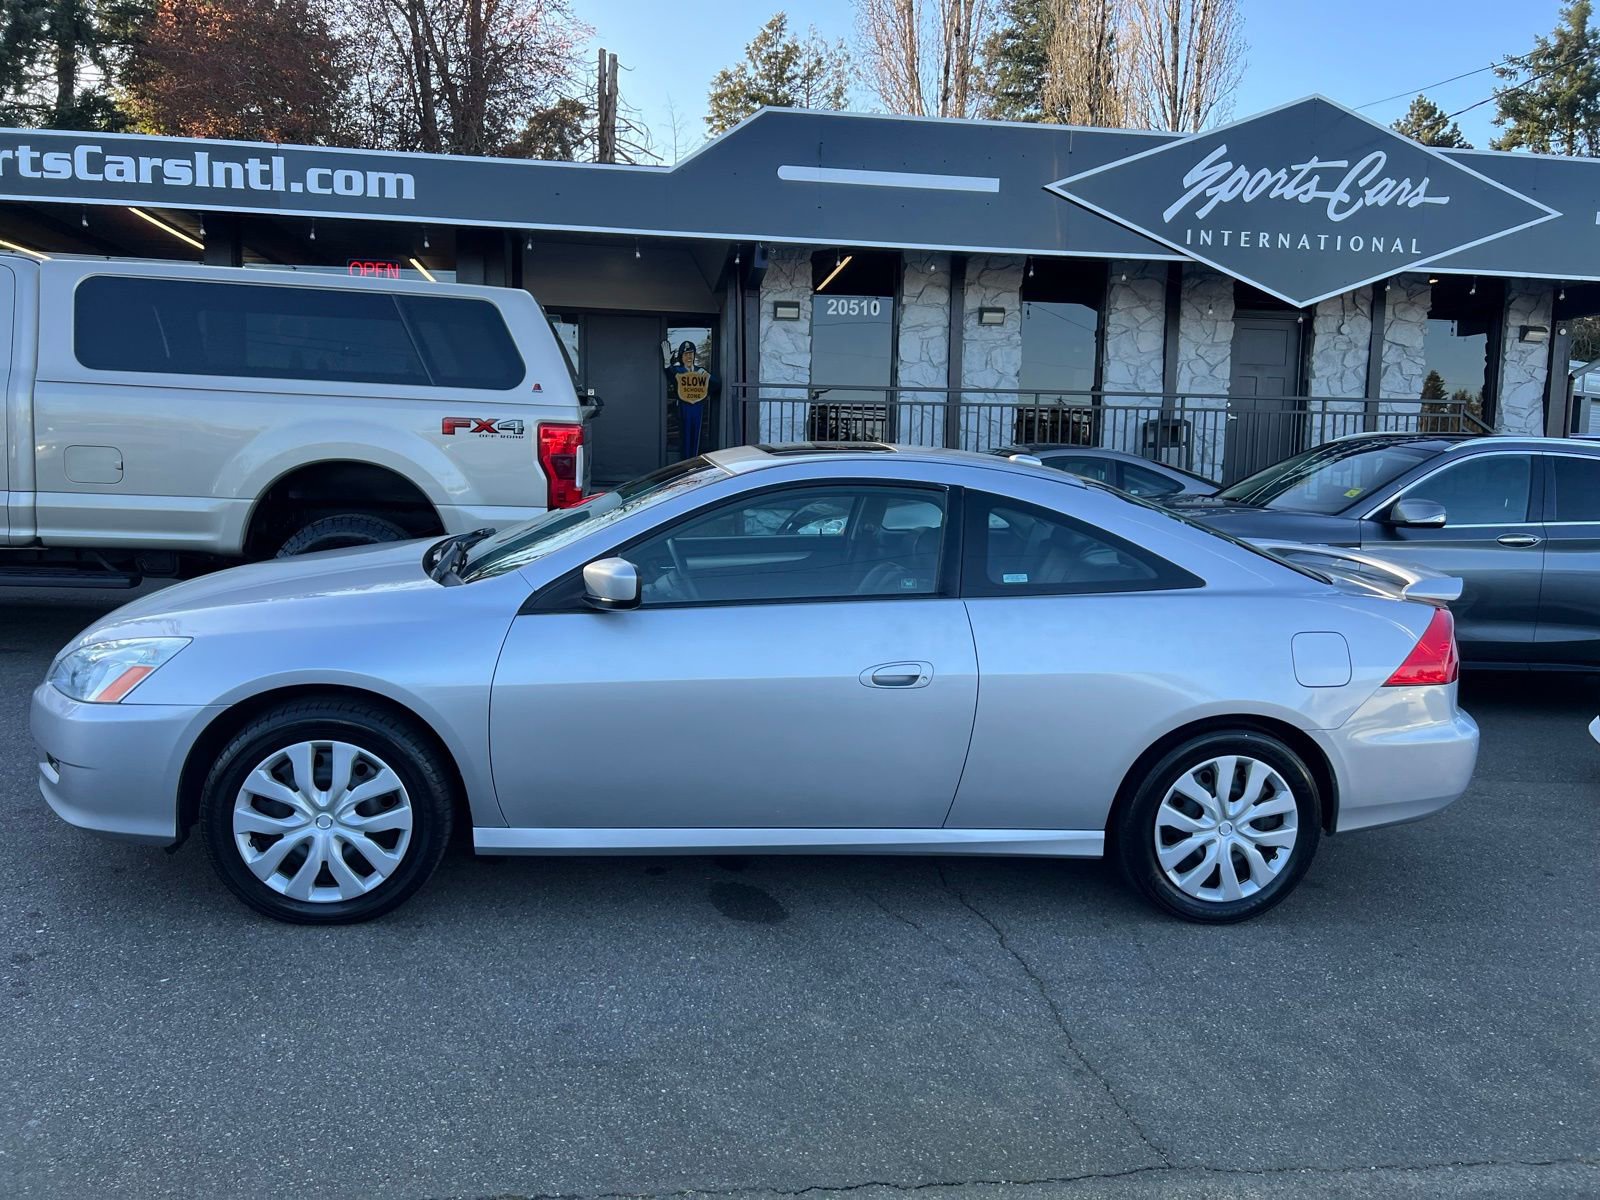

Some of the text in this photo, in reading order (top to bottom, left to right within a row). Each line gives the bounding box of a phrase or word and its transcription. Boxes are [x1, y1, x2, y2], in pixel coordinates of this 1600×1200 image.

[1163, 144, 1450, 223] Sports Cars
[1186, 229, 1422, 254] INTERNATIONAL
[349, 261, 399, 280] OPEN
[827, 299, 881, 316] 20510
[681, 376, 706, 386] SLOW
[442, 417, 524, 435] FX4
